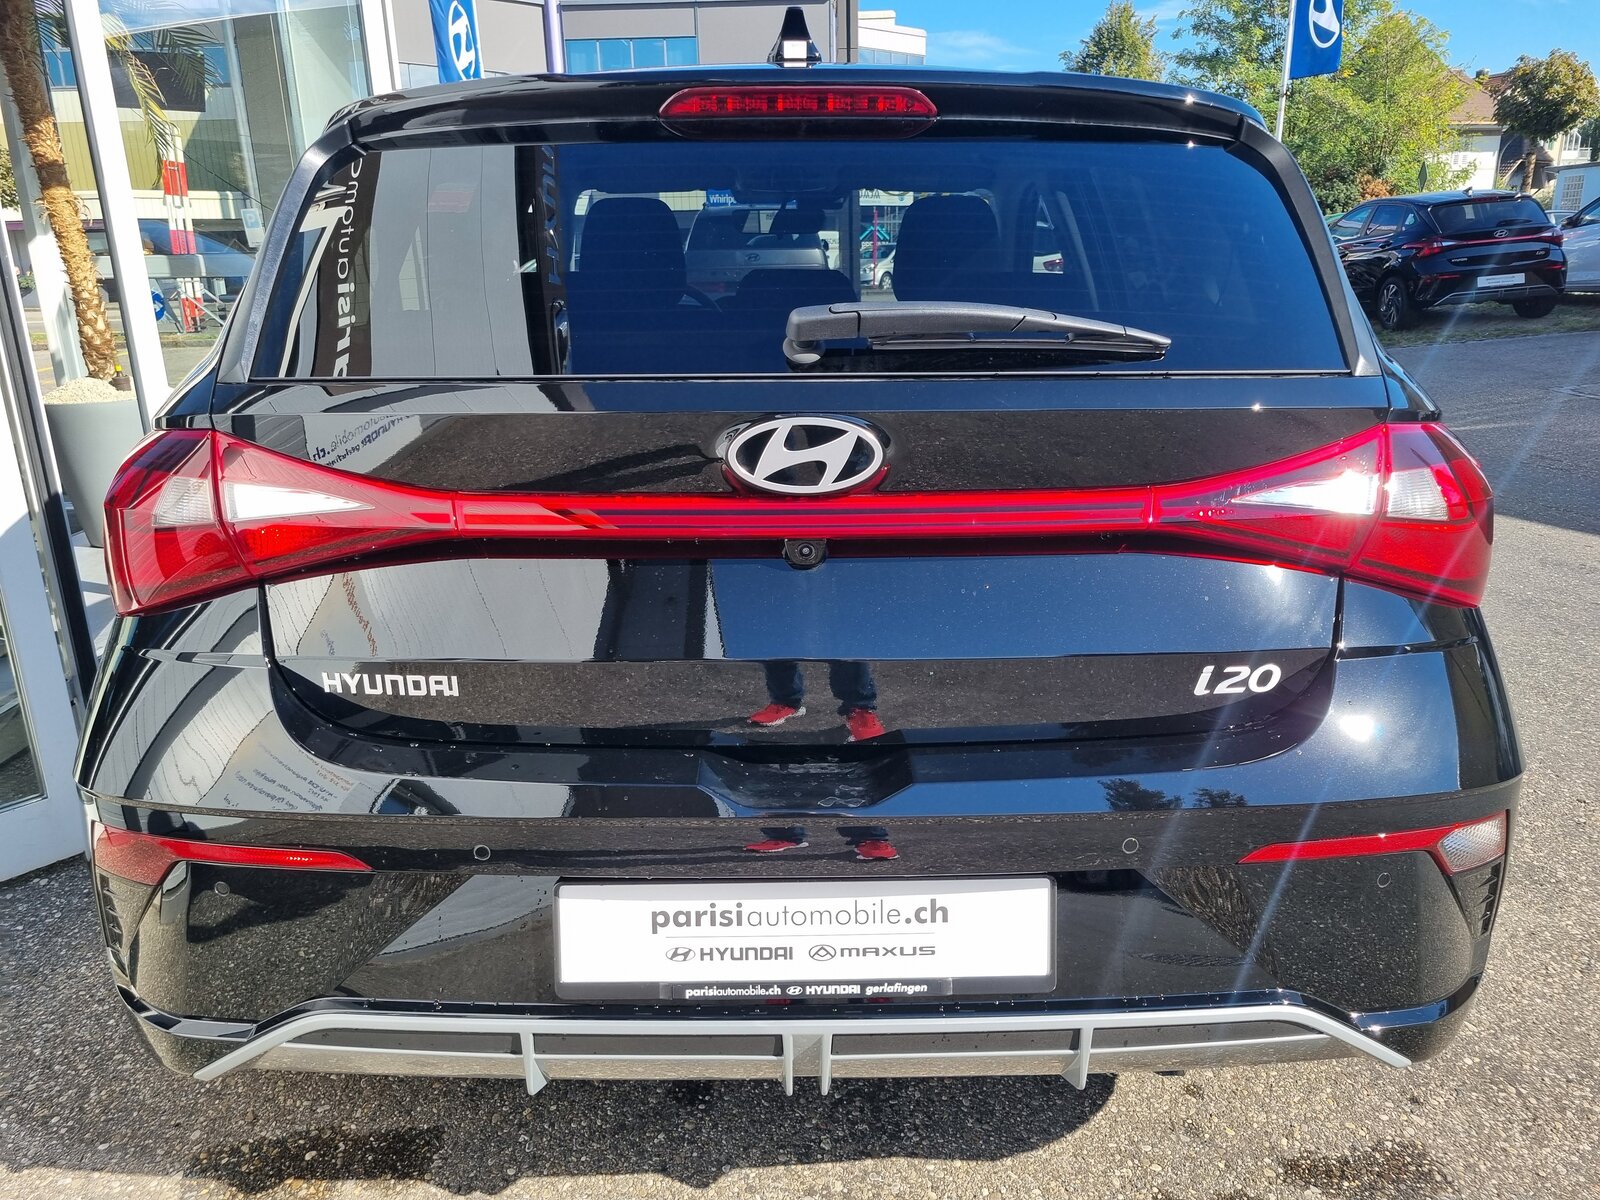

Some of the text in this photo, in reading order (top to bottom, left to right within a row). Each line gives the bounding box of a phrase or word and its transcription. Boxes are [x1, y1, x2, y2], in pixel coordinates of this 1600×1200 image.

[321, 671, 459, 697] HYUNDAI
[1193, 663, 1282, 696] i20
[651, 898, 949, 934] parisiautomobile.ch
[700, 945, 936, 961] HYUNDAI MAXUS
[685, 982, 928, 998] parisiautomobile.ch HYUNDAI gerlafingen
